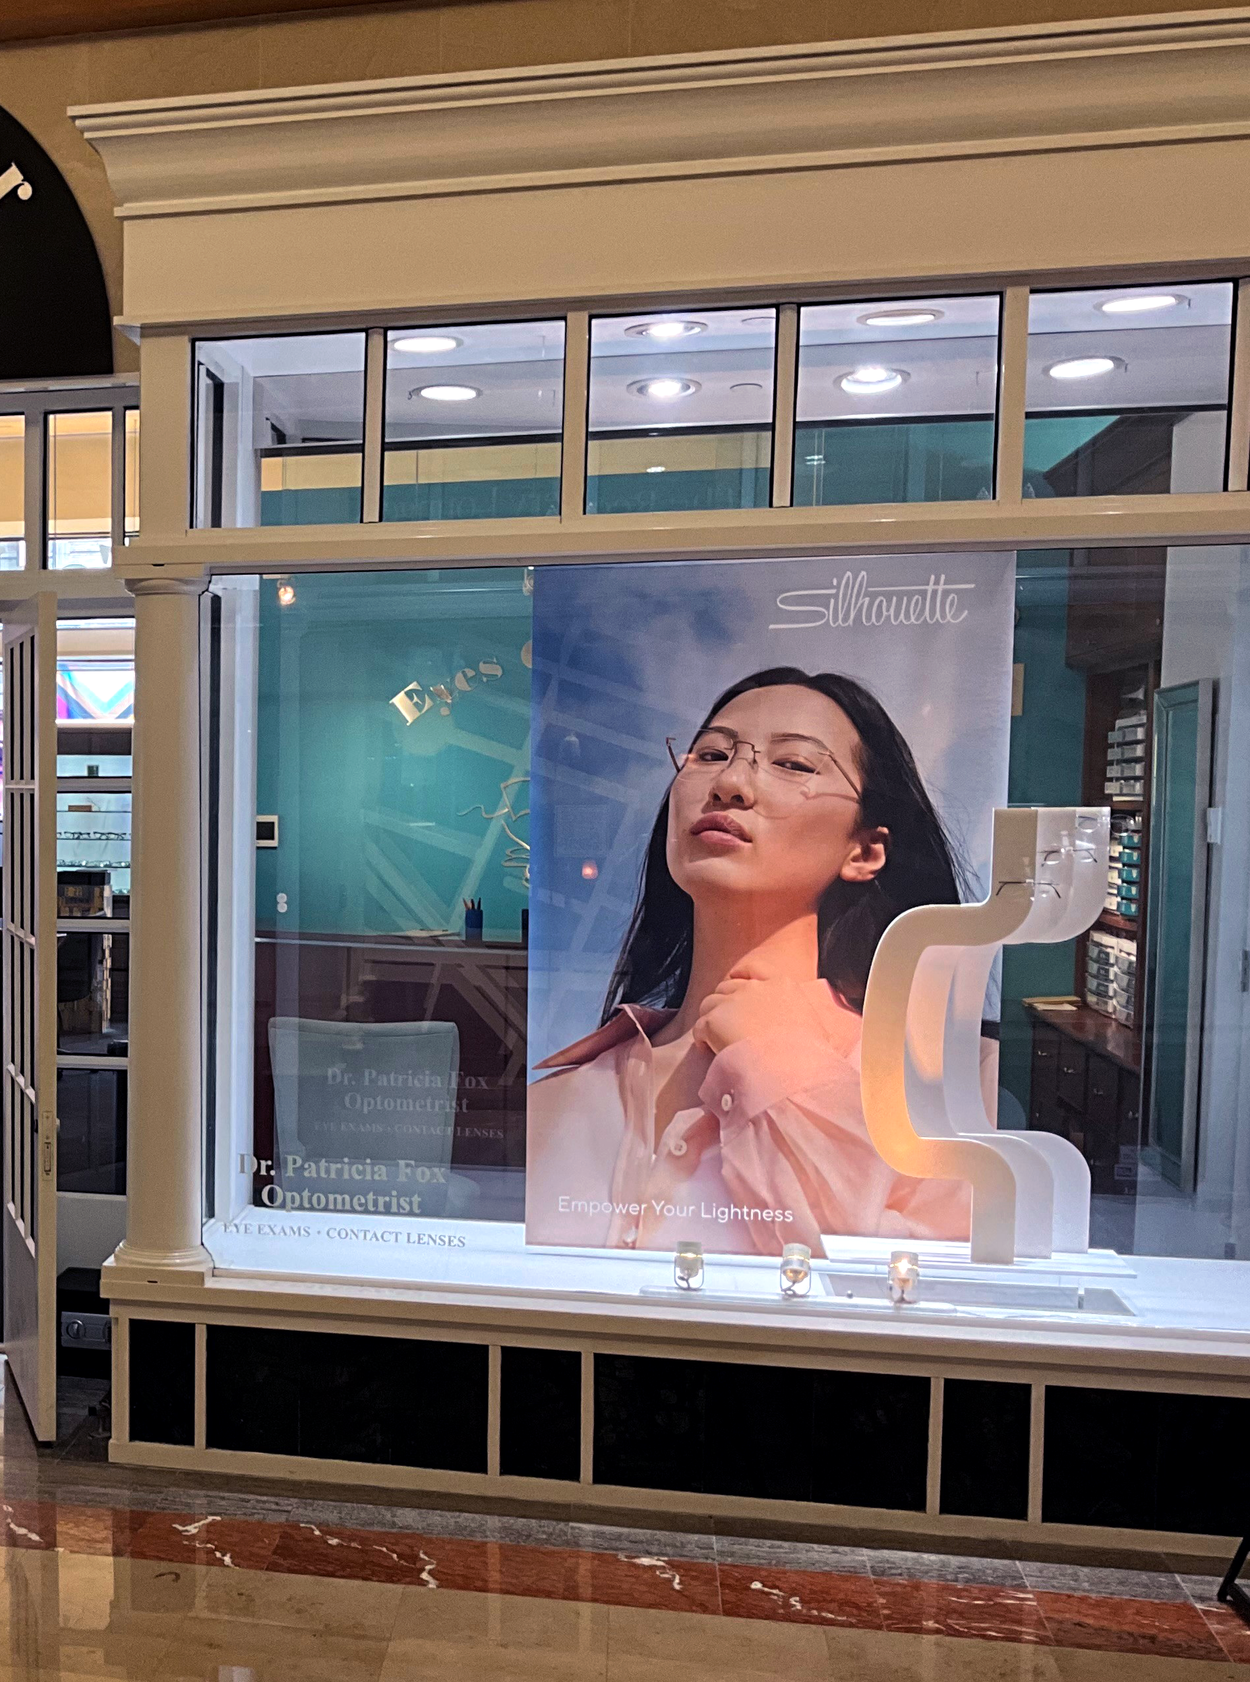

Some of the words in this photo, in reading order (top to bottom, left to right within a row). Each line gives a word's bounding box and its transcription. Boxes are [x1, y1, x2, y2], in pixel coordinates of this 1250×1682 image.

[768, 570, 976, 630] Silhouette
[389, 657, 503, 726] Eyes
[363, 1068, 442, 1089] Patricia
[449, 1071, 489, 1090] Fox
[344, 1092, 470, 1114] Optometrist
[238, 1153, 276, 1176] Dr.
[284, 1154, 388, 1181] Patricia
[397, 1159, 447, 1184] Fox
[261, 1184, 422, 1214] Optometrist
[558, 1195, 648, 1216] Empower
[651, 1199, 696, 1217] Your
[700, 1201, 794, 1223] Lightness
[223, 1222, 252, 1234] EYE
[257, 1223, 311, 1238] EXAMS
[326, 1227, 403, 1244] CONTACT
[406, 1232, 467, 1248] LENSES
